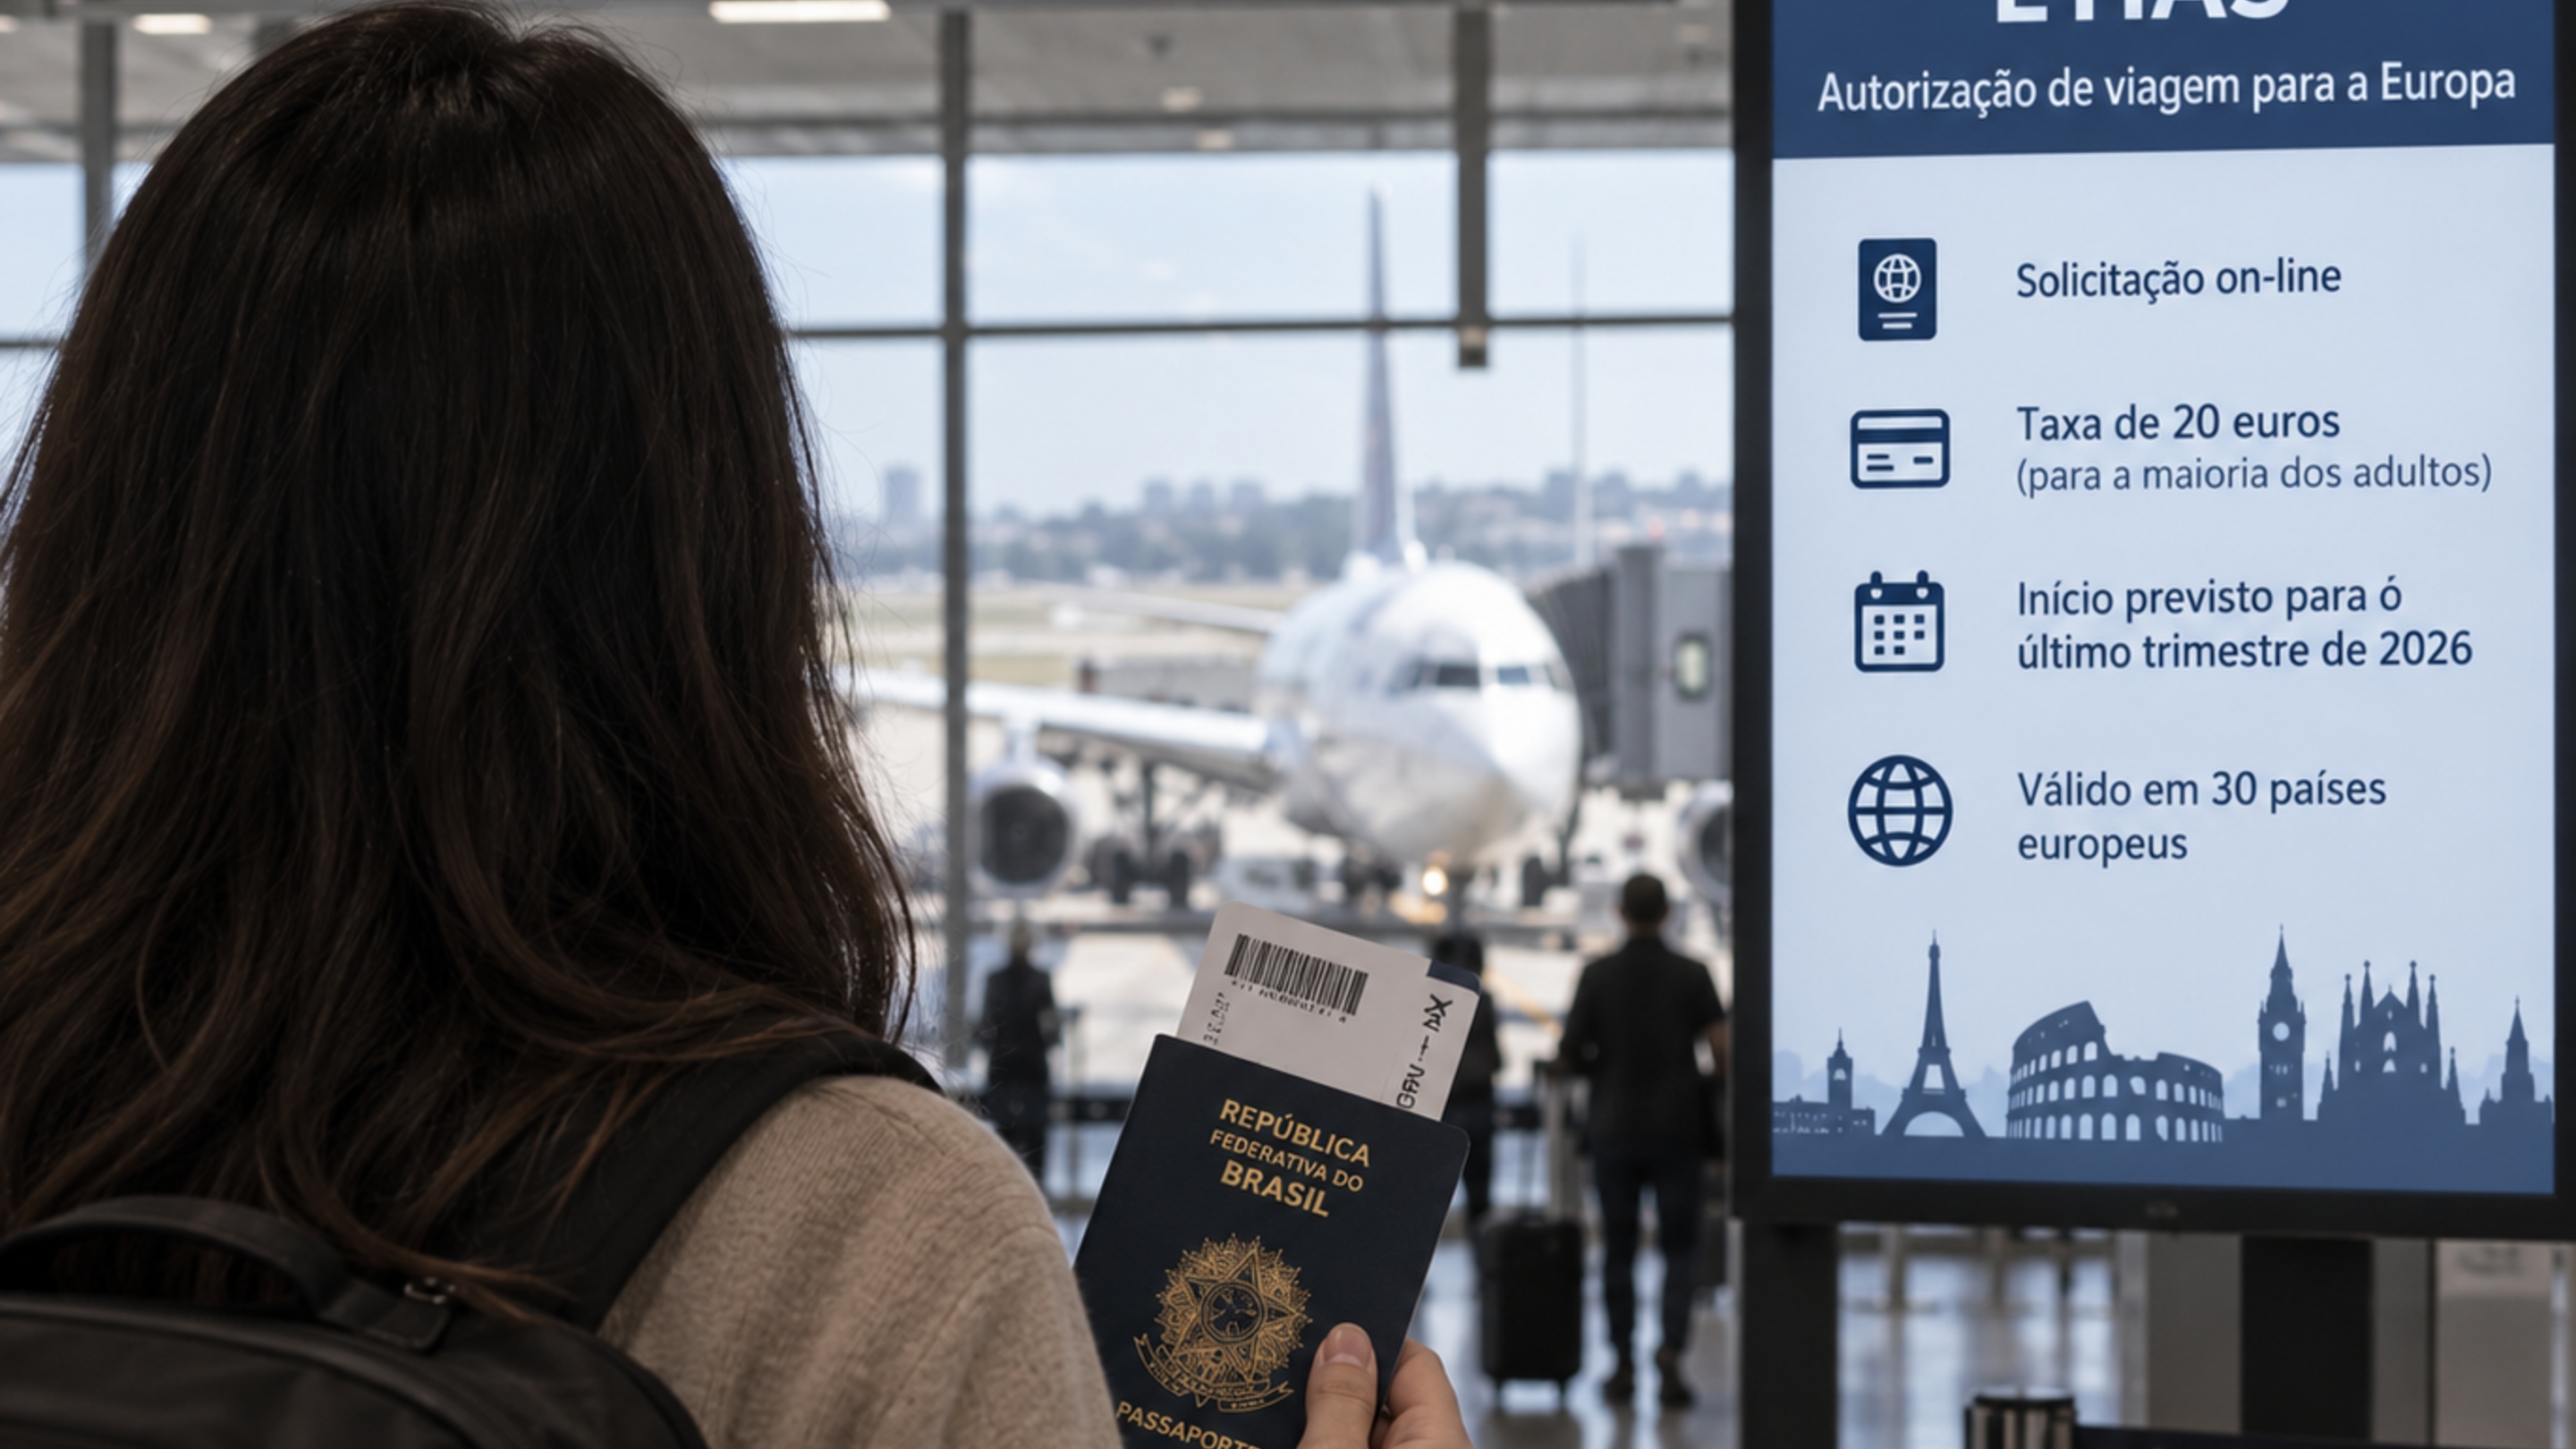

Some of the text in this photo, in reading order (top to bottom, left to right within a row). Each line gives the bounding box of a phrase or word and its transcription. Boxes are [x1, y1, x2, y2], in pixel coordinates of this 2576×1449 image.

[1818, 61, 2515, 119] Autorização de viagem para a Europa
[2017, 256, 2342, 305] Solicitação on-line
[2016, 402, 2341, 442] Taxa de 20 euros
[2017, 453, 2492, 499] (para a maioria dos adultos)
[2019, 580, 2114, 616] Início
[2126, 578, 2274, 624] previsto
[2286, 585, 2367, 622] para
[2018, 629, 2473, 670] último trimestre de 2026
[2017, 768, 2387, 815] Válido em 30 países
[2018, 834, 2188, 869] europeus
[1219, 1097, 1370, 1168] REPÚBLICA
[1209, 1129, 1364, 1192] FEDERATIVA DO
[1219, 1158, 1330, 1218] BRASIL
[1116, 1401, 1262, 1449] PASSAPORT
